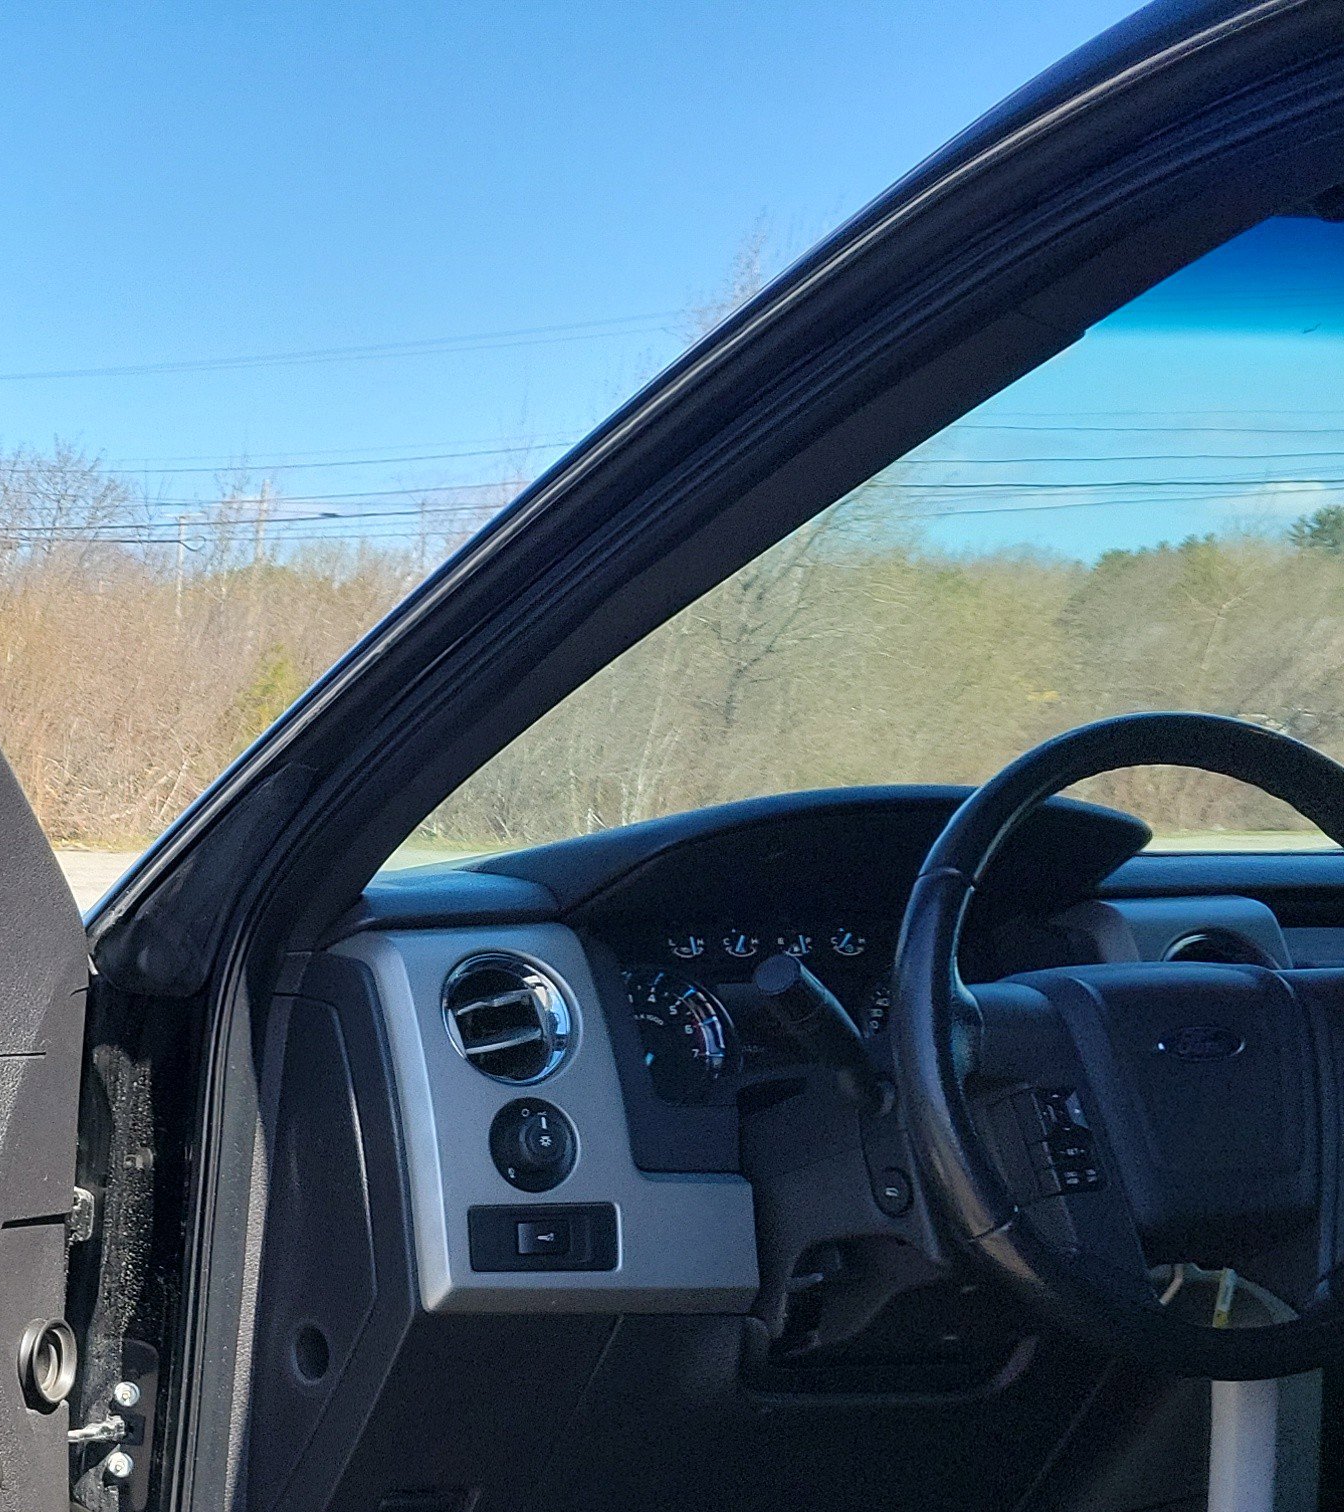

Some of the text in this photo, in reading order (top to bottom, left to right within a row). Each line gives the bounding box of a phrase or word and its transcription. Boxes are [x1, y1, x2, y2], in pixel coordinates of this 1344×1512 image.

[668, 1004, 678, 1015] 5
[684, 1024, 694, 1035] 6
[692, 1047, 700, 1058] 7
